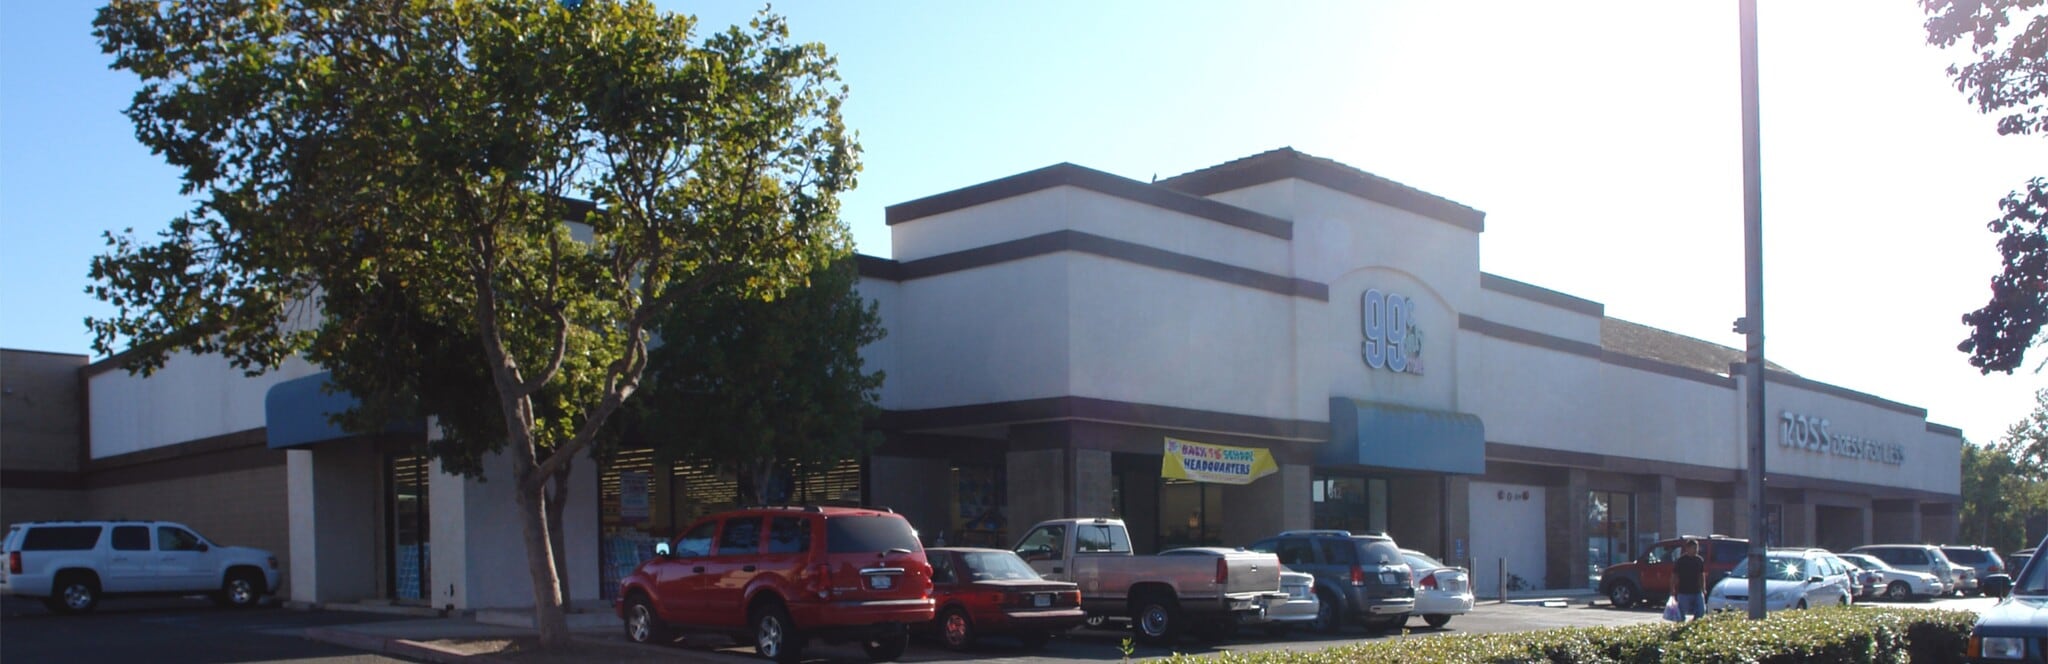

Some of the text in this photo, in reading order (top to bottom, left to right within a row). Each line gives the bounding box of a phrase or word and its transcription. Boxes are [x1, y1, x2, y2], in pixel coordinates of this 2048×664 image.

[1779, 411, 1830, 453] ROSS
[1181, 444, 1207, 458] BACK
[1208, 447, 1222, 460] TO
[1223, 449, 1255, 462] SCHOOL
[1183, 457, 1251, 475] HEADQUARTERS
